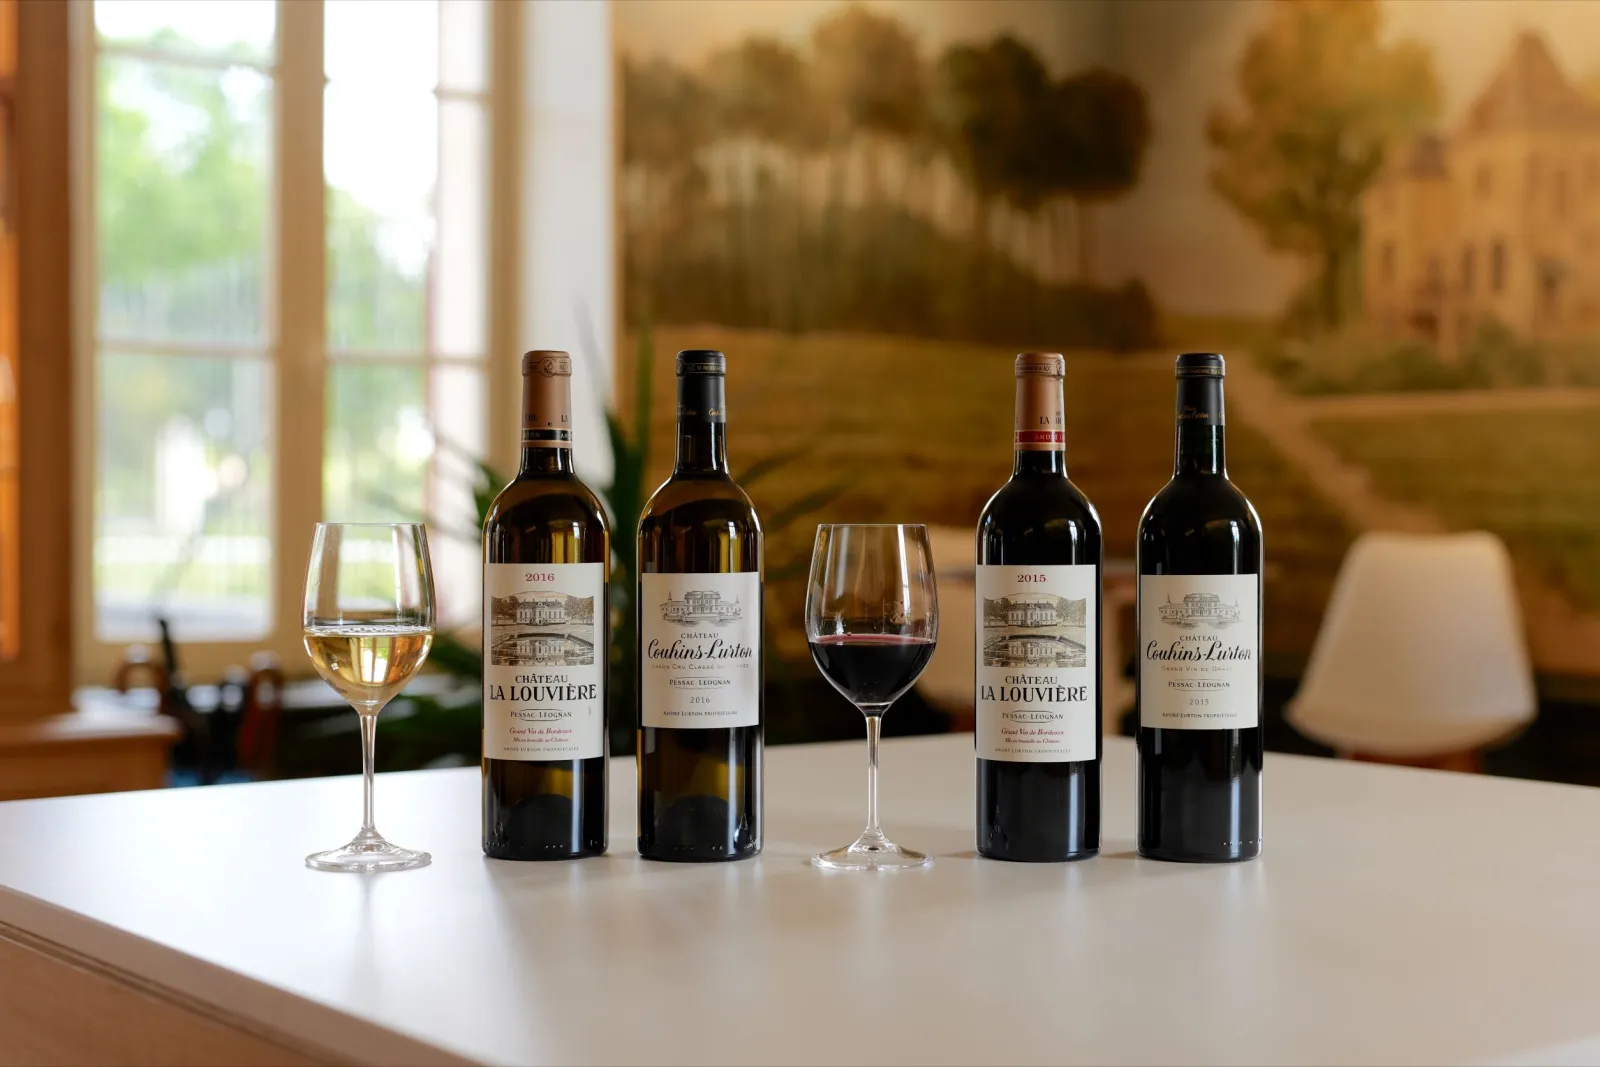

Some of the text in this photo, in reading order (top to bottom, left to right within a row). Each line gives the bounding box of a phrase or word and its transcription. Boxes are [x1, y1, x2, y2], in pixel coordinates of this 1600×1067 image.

[525, 573, 555, 582] 2016
[1017, 574, 1046, 583] 2015
[680, 631, 719, 639] CHÂTEAU
[1179, 633, 1218, 641] CHÂTEAU
[648, 638, 753, 660] Couhins-Lurton
[1146, 639, 1251, 661] Couhins-Lurton
[515, 673, 568, 684] CHÂTEAU
[1005, 673, 1058, 685] CHÂTEAU
[490, 683, 597, 702] LA LOUVIÈRE
[981, 685, 1088, 702] LA LOUVIÈRE
[690, 696, 711, 704] 2016
[1189, 698, 1209, 706] 2015
